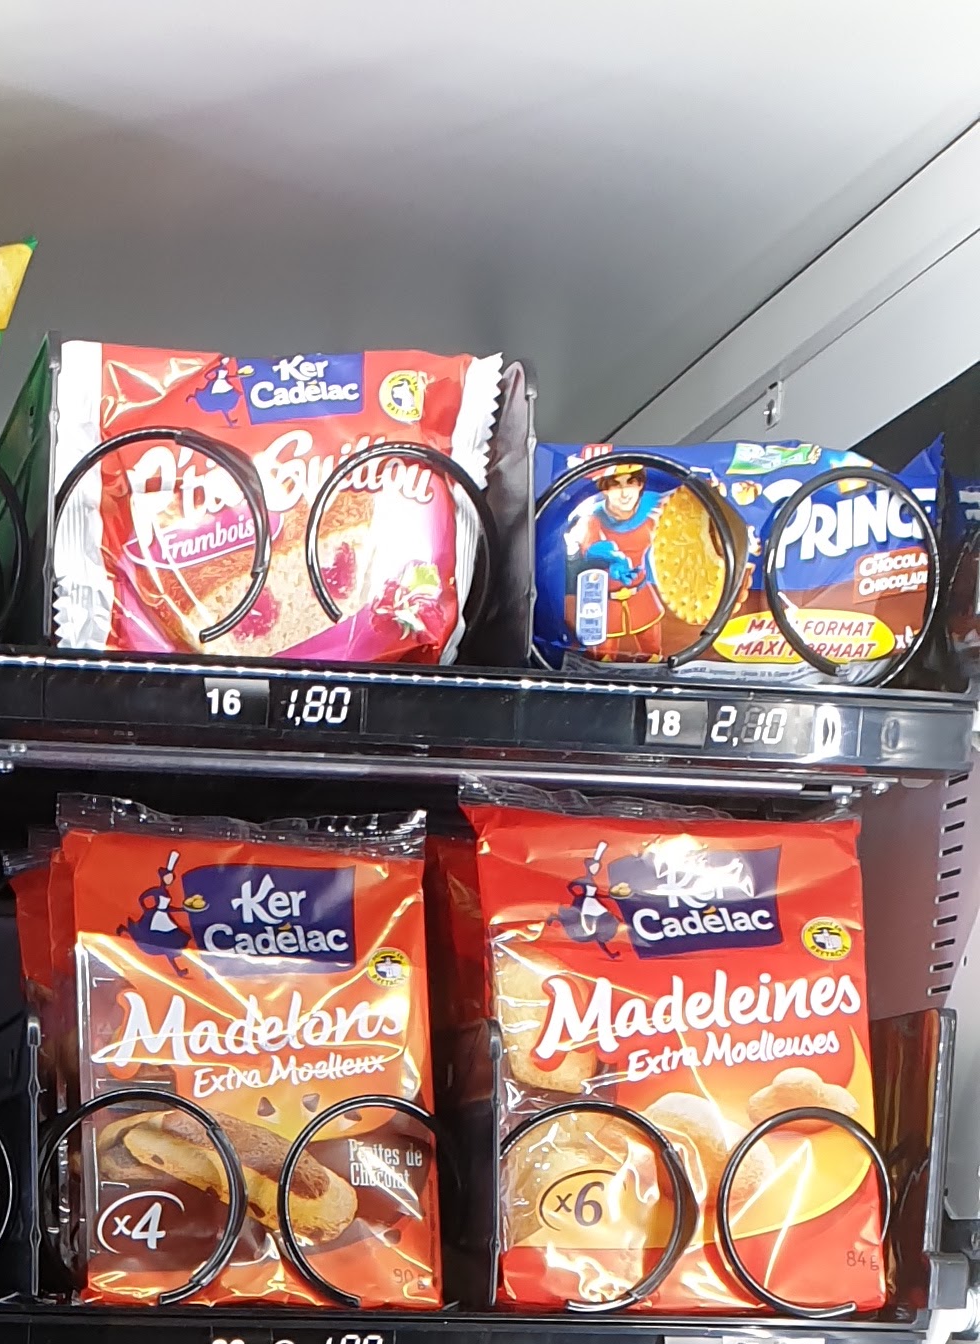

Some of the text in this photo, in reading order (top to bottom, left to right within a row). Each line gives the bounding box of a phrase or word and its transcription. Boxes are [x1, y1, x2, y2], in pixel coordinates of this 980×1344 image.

[274, 354, 329, 380] Ker
[250, 378, 360, 409] Cadélac
[803, 620, 876, 637] FORMAT
[734, 639, 786, 656] MAXI
[206, 688, 242, 715] 16
[287, 685, 351, 724] 1,80
[647, 710, 681, 736] 18
[710, 705, 787, 747] 2,10
[231, 872, 308, 924] Ker
[203, 921, 349, 957] Cadélac
[632, 905, 775, 942] Cadélac
[103, 992, 404, 1066] Madelons
[535, 969, 863, 1060] Madeleines
[627, 1028, 841, 1083] Extra Moelleuses
[192, 1050, 387, 1099] Extra Moelleux
[405, 1142, 424, 1167] de
[554, 1179, 606, 1229] x6
[111, 1201, 167, 1251] x4
[845, 1248, 867, 1268] 84
